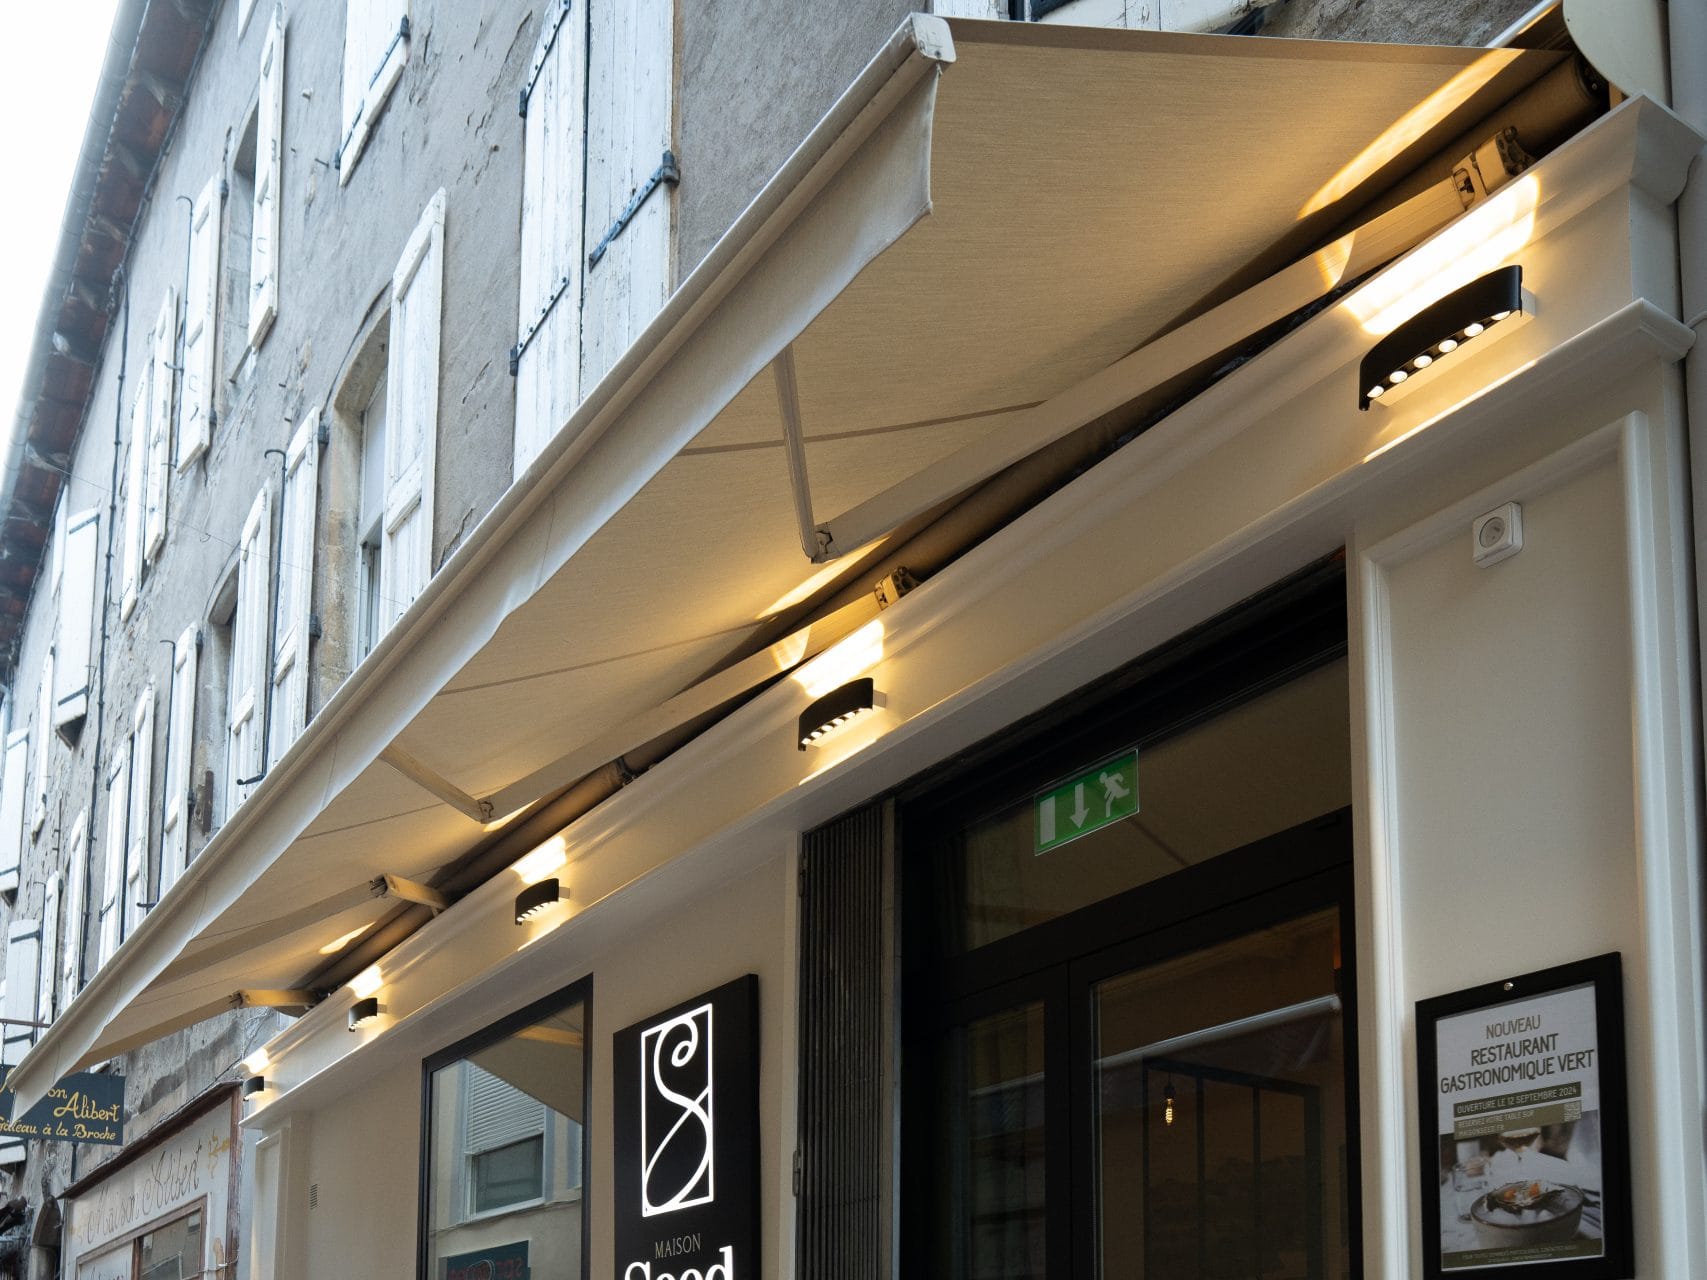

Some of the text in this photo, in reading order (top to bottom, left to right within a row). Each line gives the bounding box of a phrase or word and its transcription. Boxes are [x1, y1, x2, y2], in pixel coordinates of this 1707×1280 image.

[1486, 1015, 1541, 1040] NOUVEAU
[1471, 1033, 1559, 1067] RESTAURANT
[1440, 1049, 1595, 1094] GASTRONOMIQUE VERT
[54, 1092, 120, 1122] Alibert
[1457, 1086, 1577, 1114] OUVERTURE LE 12 SEPTEMBRE 2024
[42, 1123, 52, 1135] à
[56, 1121, 69, 1137] la
[73, 1123, 117, 1140] Broche
[655, 1233, 701, 1260] MAISON
